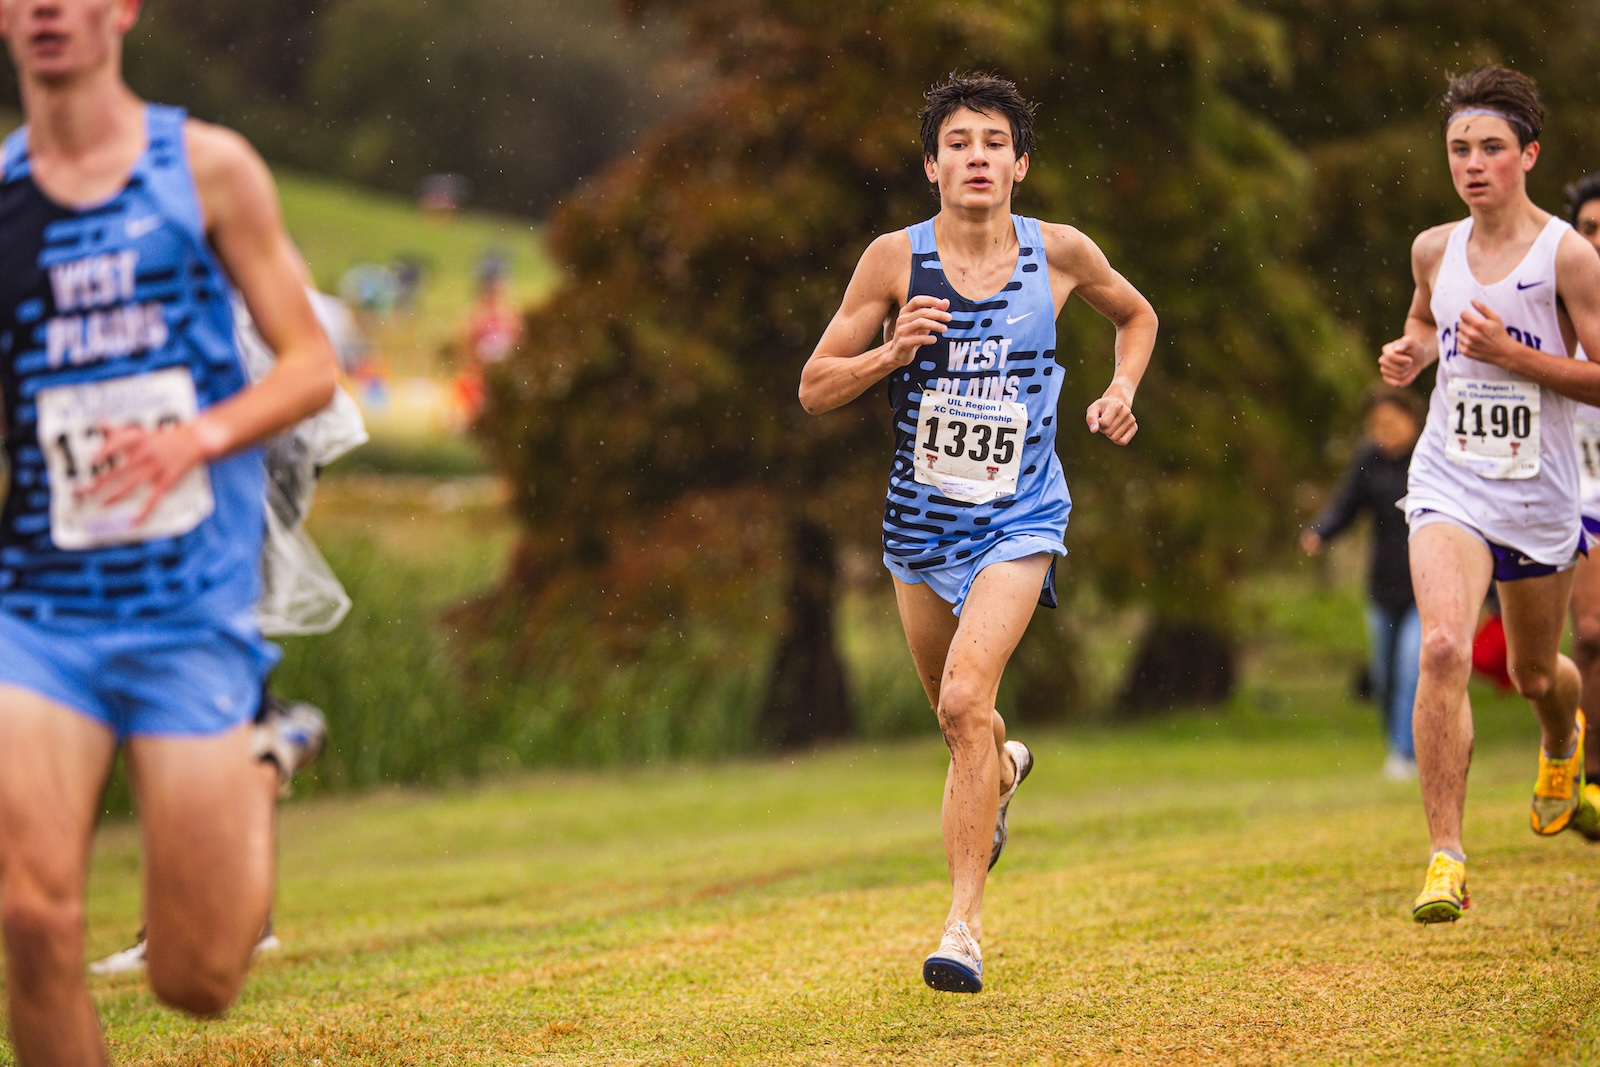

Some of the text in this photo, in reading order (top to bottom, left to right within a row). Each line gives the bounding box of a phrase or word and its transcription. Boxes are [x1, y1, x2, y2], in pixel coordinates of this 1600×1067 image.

[50, 248, 138, 312] WEST
[46, 302, 169, 369] PLAINS
[949, 338, 1013, 371] WEST
[933, 405, 1013, 424] XC Championship
[947, 398, 963, 408] UIL
[965, 401, 996, 412] Region
[1455, 402, 1531, 439] 1190
[922, 416, 1018, 465] 1335
